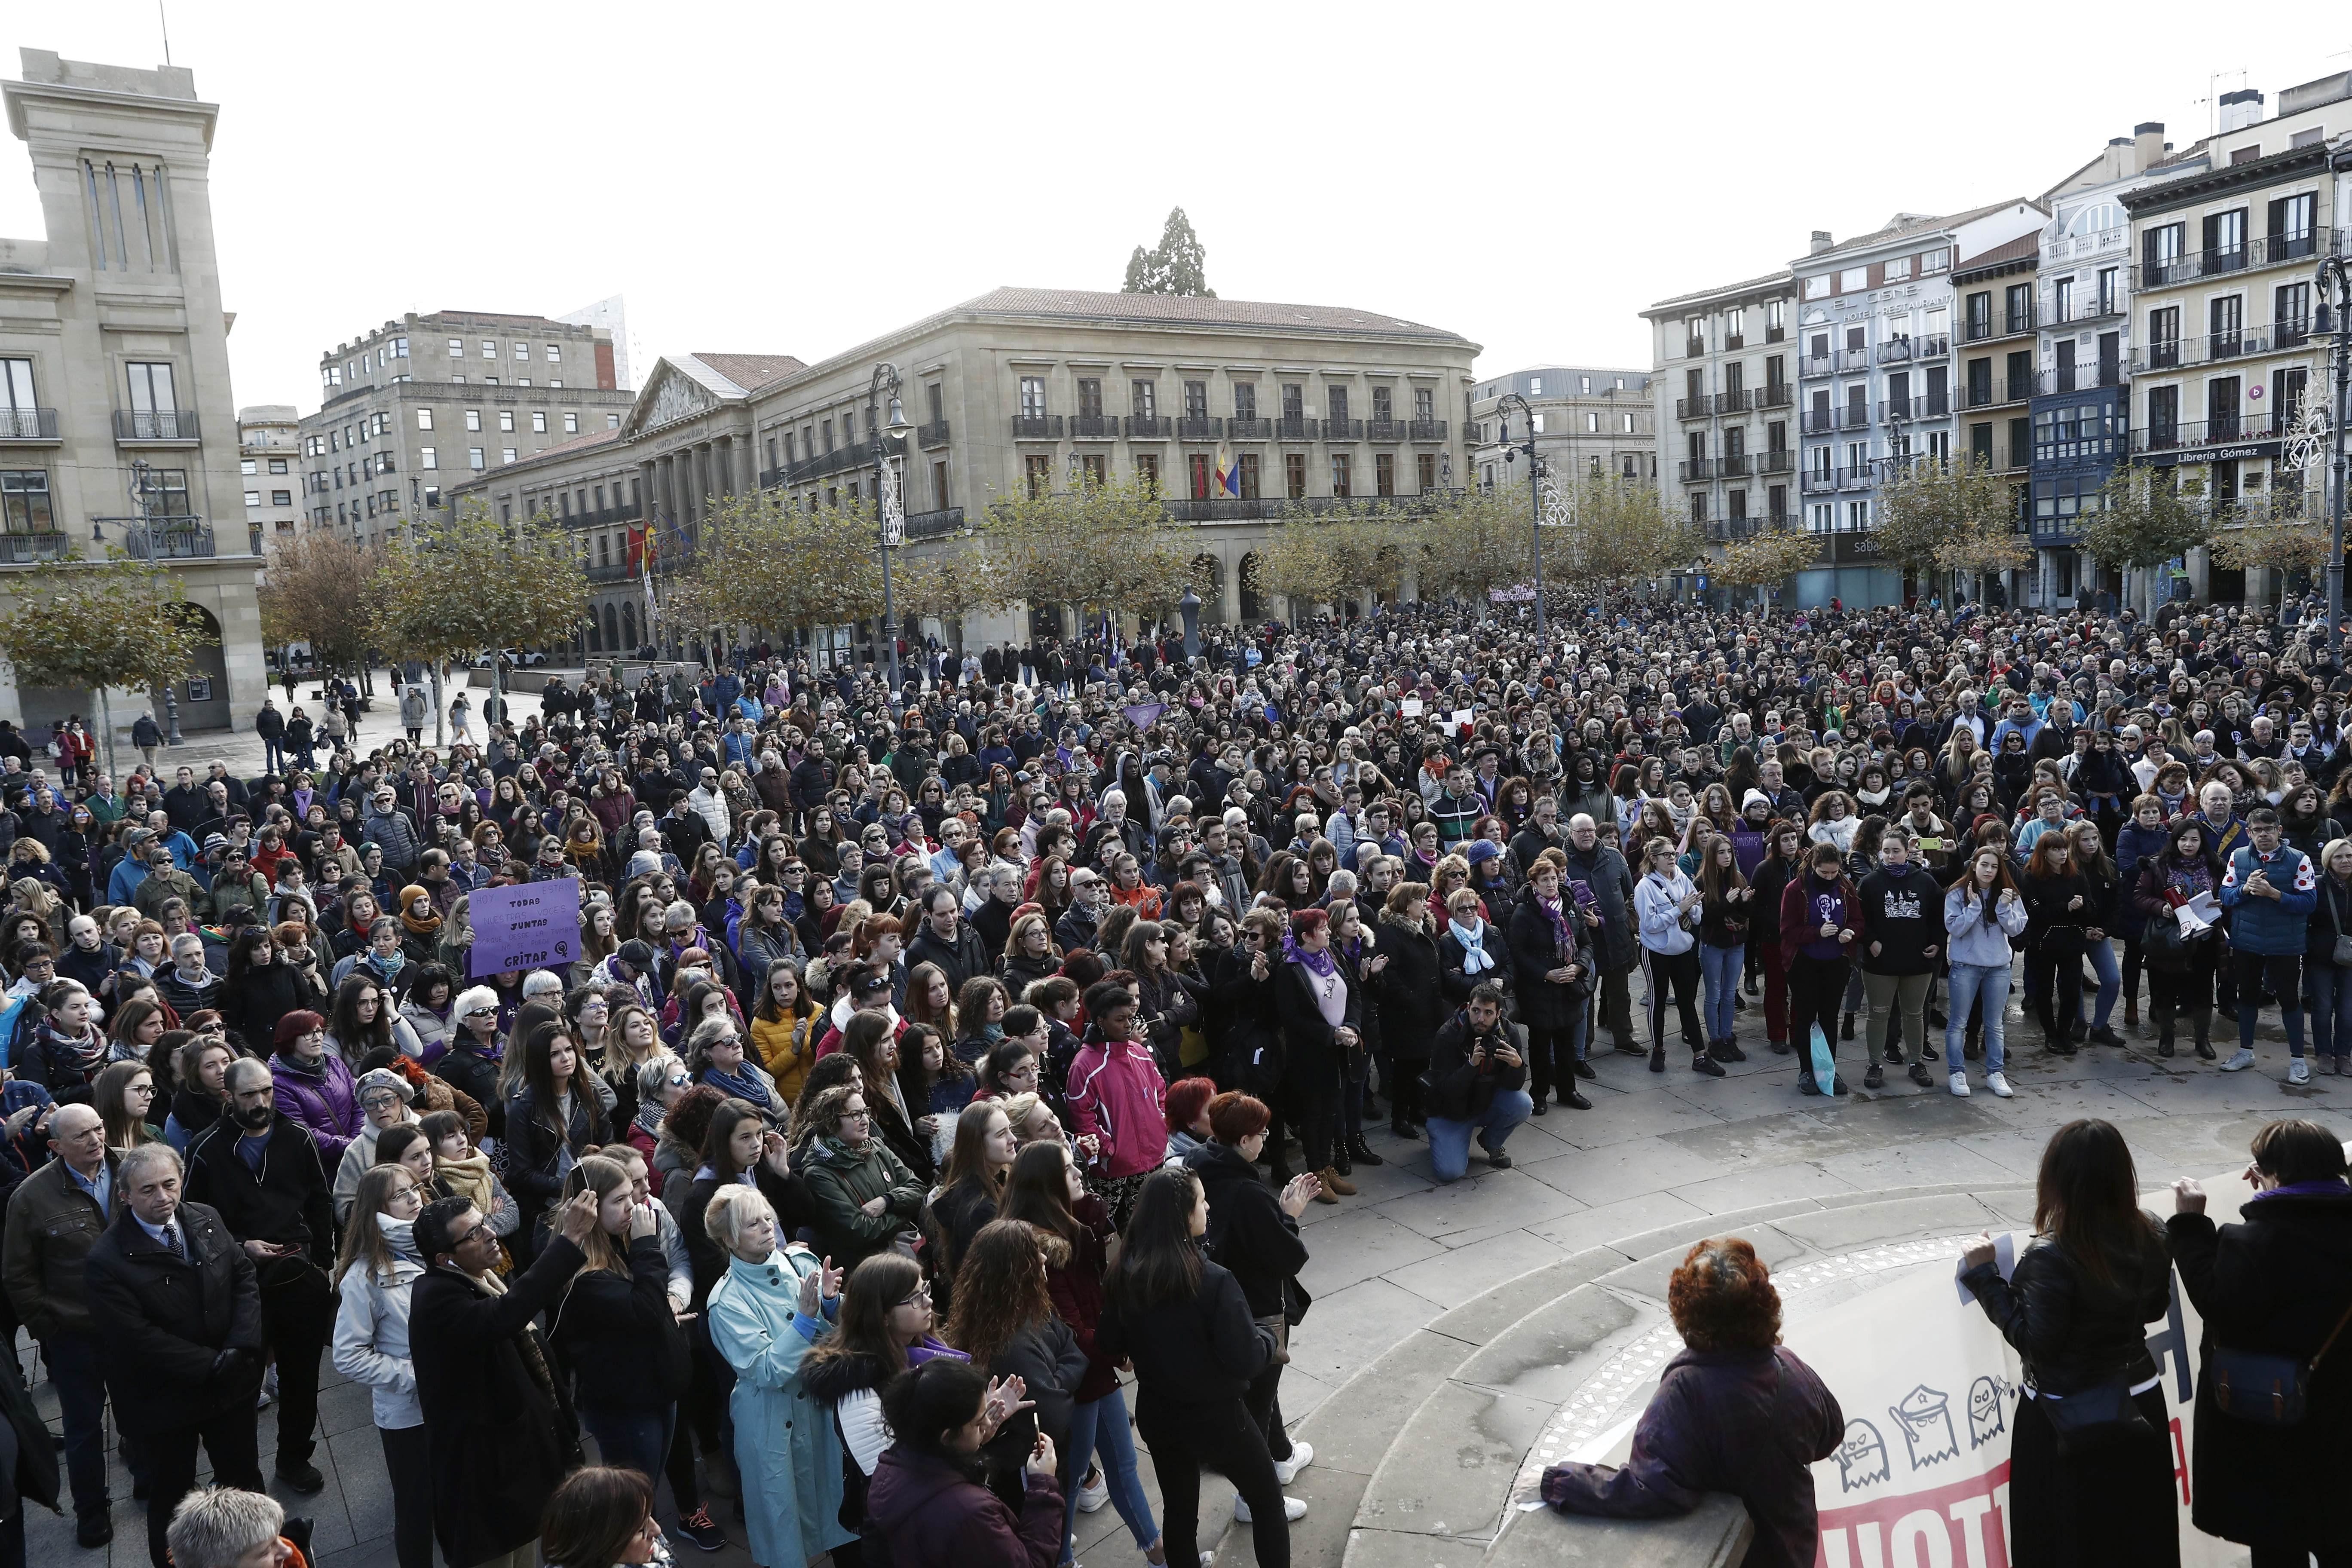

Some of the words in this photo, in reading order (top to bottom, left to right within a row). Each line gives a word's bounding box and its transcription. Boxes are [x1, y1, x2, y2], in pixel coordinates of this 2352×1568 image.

[2178, 450, 2215, 462] Librería
[2220, 447, 2257, 459] Gómez
[1699, 579, 1703, 587] P
[476, 894, 494, 905] HOY
[514, 888, 528, 898] NO
[542, 882, 572, 894] ESTÁN
[509, 897, 540, 908] TODAS
[484, 912, 527, 925] NUESTRAS
[537, 904, 566, 916] VOCES
[510, 919, 548, 931] JUNTAS
[477, 936, 502, 946] PORQUE
[509, 932, 529, 941] DESDE
